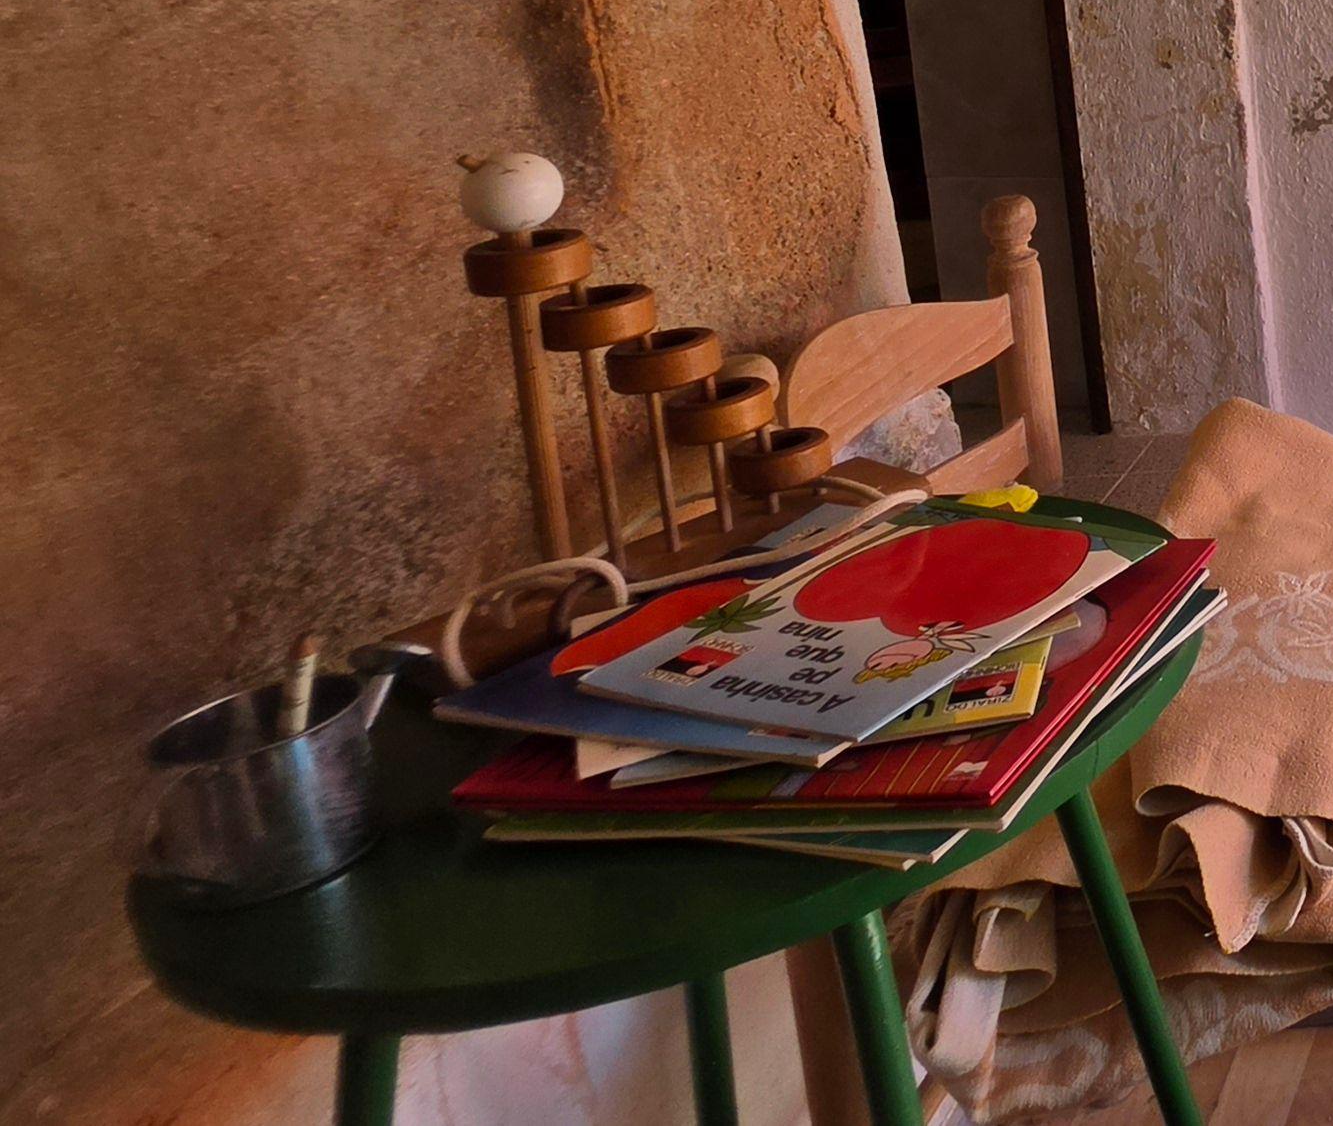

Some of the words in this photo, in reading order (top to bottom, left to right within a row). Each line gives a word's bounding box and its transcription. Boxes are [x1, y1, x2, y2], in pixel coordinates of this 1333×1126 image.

[778, 621, 842, 642] nina
[785, 644, 846, 664] que
[789, 667, 842, 685] pe
[709, 675, 825, 706] casinha
[816, 694, 856, 713] A
